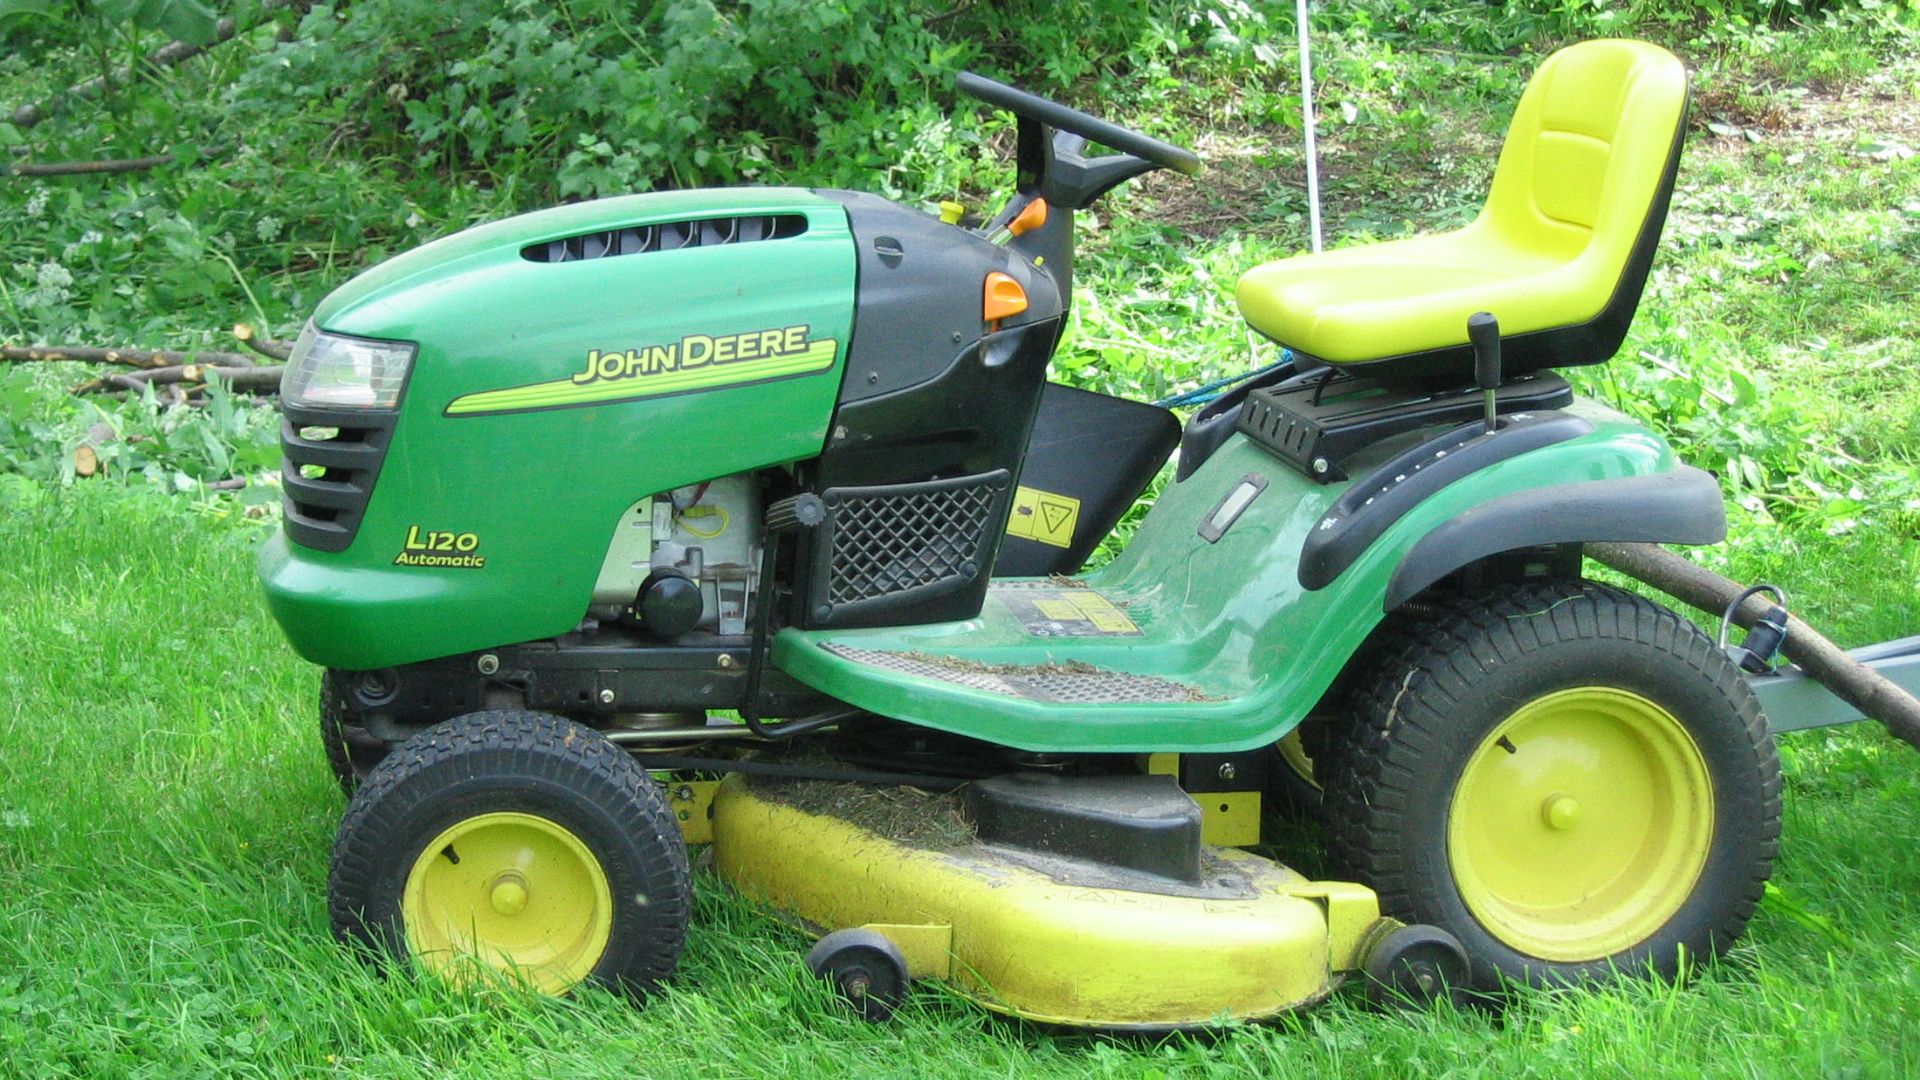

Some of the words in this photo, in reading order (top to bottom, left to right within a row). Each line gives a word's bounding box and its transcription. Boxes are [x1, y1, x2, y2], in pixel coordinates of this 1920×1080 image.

[572, 344, 677, 383] JOHN
[681, 325, 808, 367] DEERE
[405, 525, 478, 552] L120
[394, 552, 485, 567] Automatic
